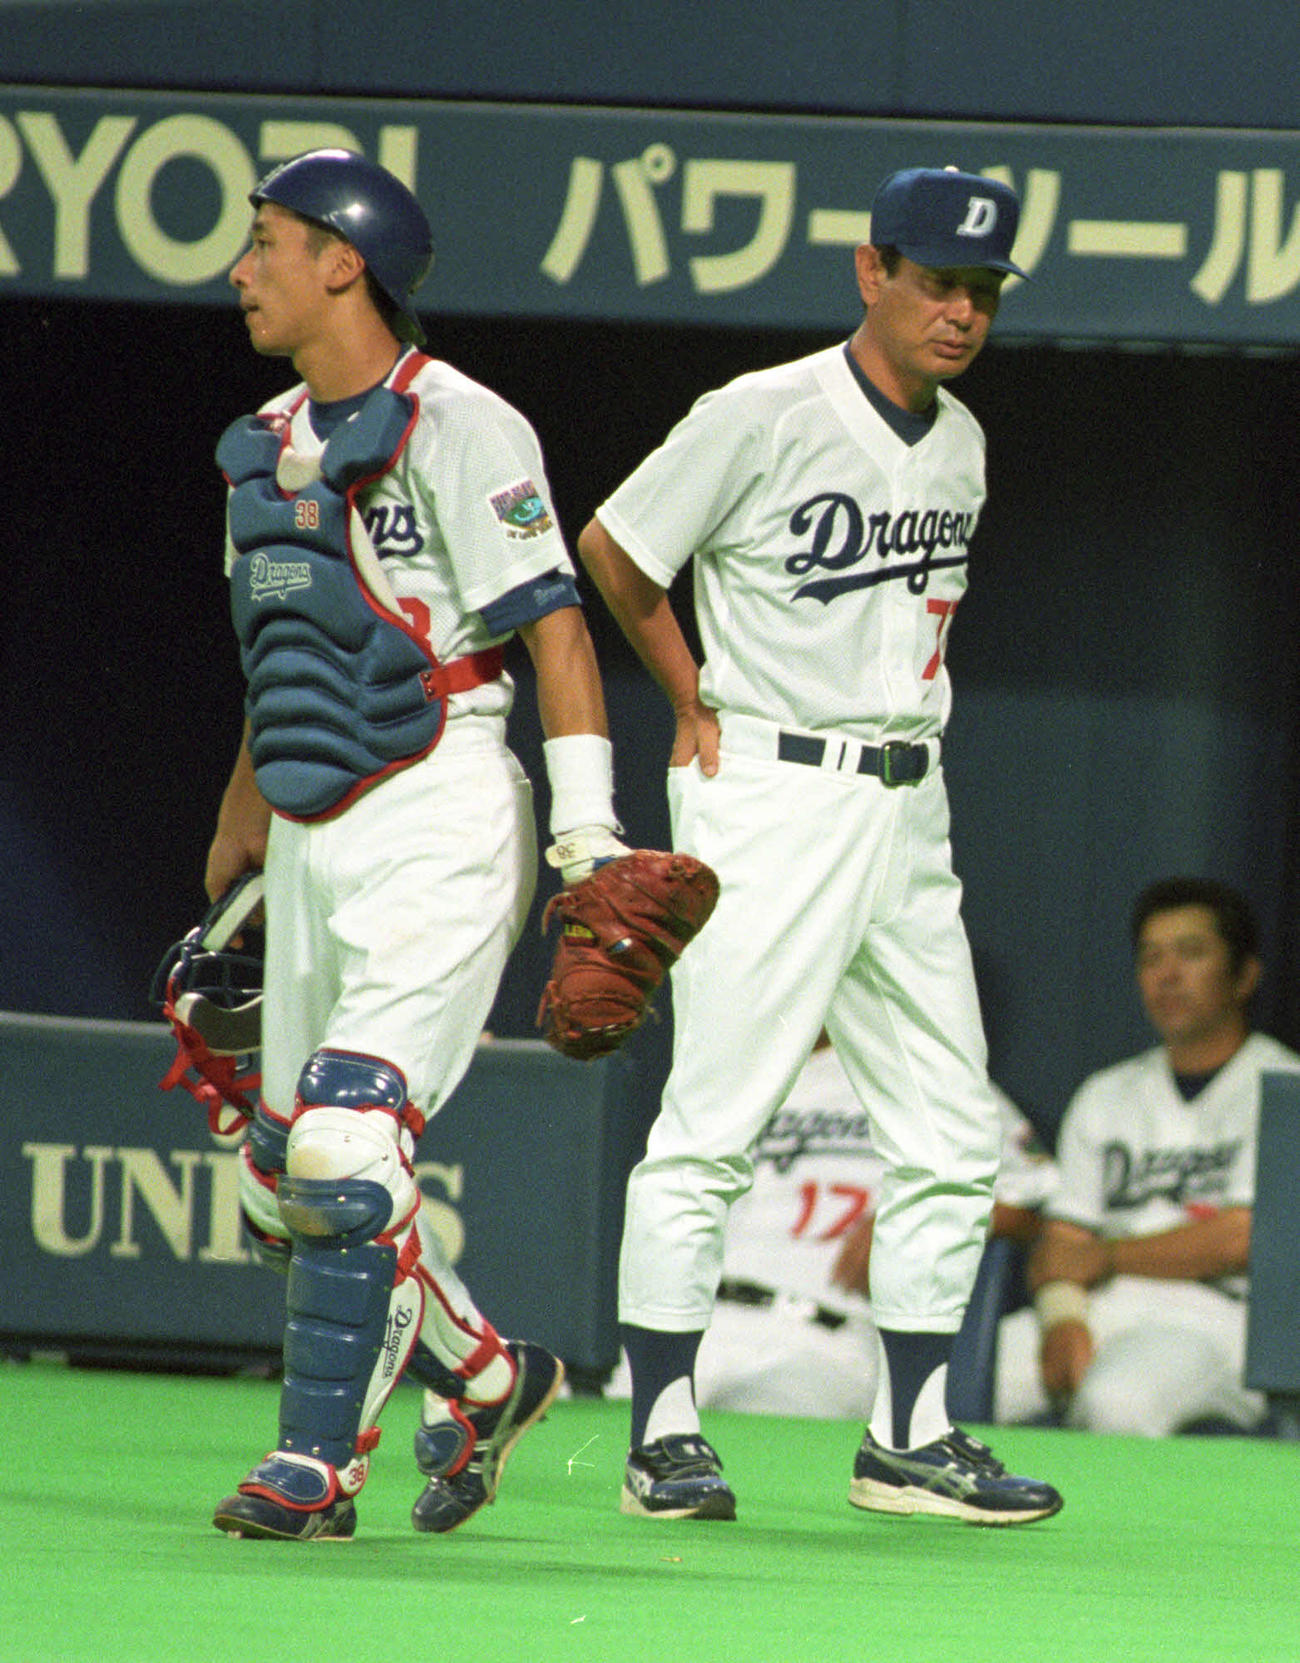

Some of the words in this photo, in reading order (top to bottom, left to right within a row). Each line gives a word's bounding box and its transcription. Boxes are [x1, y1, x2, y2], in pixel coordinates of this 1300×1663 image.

[956, 196, 998, 238] D
[295, 500, 319, 530] 38
[249, 552, 312, 601] Dragons
[21, 1141, 465, 1268] UNIS
[791, 1180, 869, 1242] 17
[348, 1463, 365, 1486] 38
